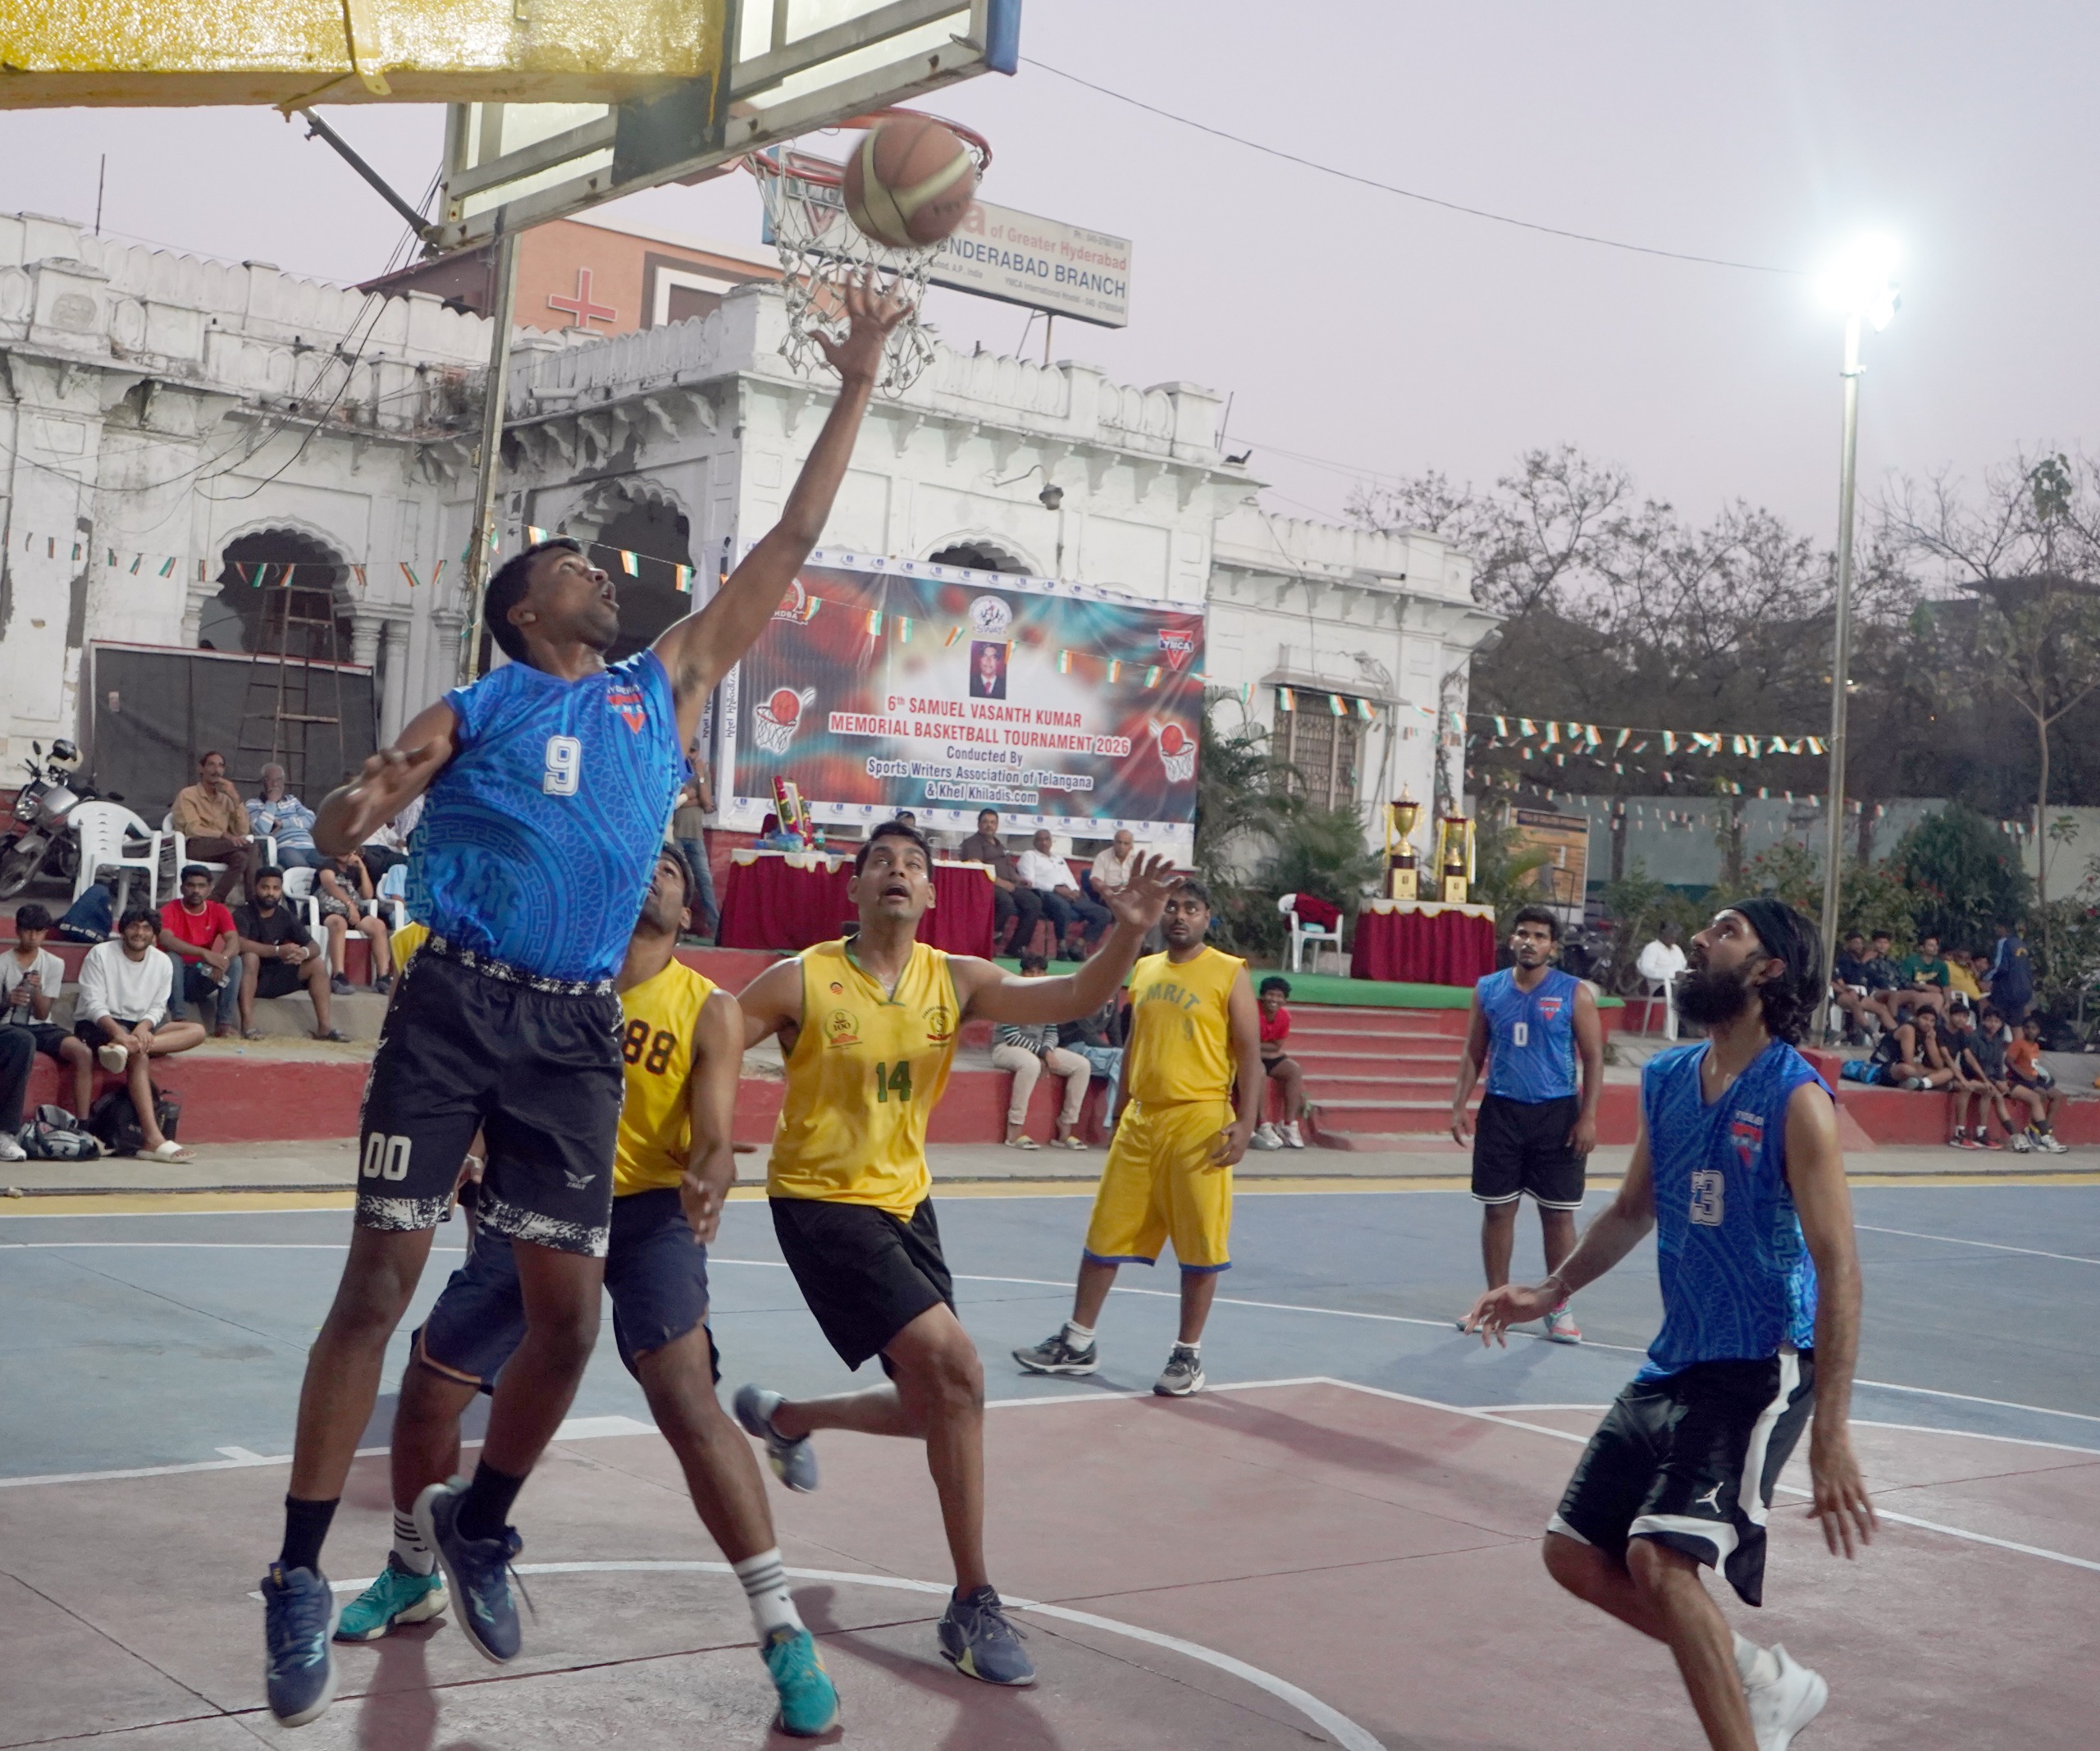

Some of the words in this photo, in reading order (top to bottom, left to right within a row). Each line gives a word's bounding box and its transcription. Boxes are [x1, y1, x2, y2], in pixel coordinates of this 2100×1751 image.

[990, 225, 1004, 239] of
[1007, 227, 1056, 253] Greater
[1060, 241, 1127, 271] Hyderabad
[1055, 264, 1126, 299] BRANCH
[888, 696, 905, 711] 6th
[909, 697, 966, 718] SAMUEL
[970, 703, 1031, 724] VASANTH
[1035, 709, 1082, 728] KUMAR
[831, 715, 910, 736] MEMORIAL
[915, 721, 999, 744] BASKETBALL
[1004, 729, 1093, 752] TOURNAMENT
[1096, 738, 1130, 755] 2026
[543, 734, 582, 796] 9
[868, 759, 907, 775] Sports
[911, 761, 952, 779] Writers
[956, 766, 1019, 783] Association
[1023, 772, 1034, 784] of
[1038, 772, 1092, 789] Telangana
[947, 746, 1007, 763] Conducted
[1010, 751, 1023, 767] By
[927, 784, 934, 797] &
[939, 784, 964, 798] Khel
[969, 786, 1037, 803] Khiladis.com
[622, 1018, 678, 1076] 88
[1514, 1022, 1528, 1047] 0
[876, 1060, 912, 1103] 14
[363, 1132, 412, 1182] 00
[1690, 1169, 1724, 1226] 3
